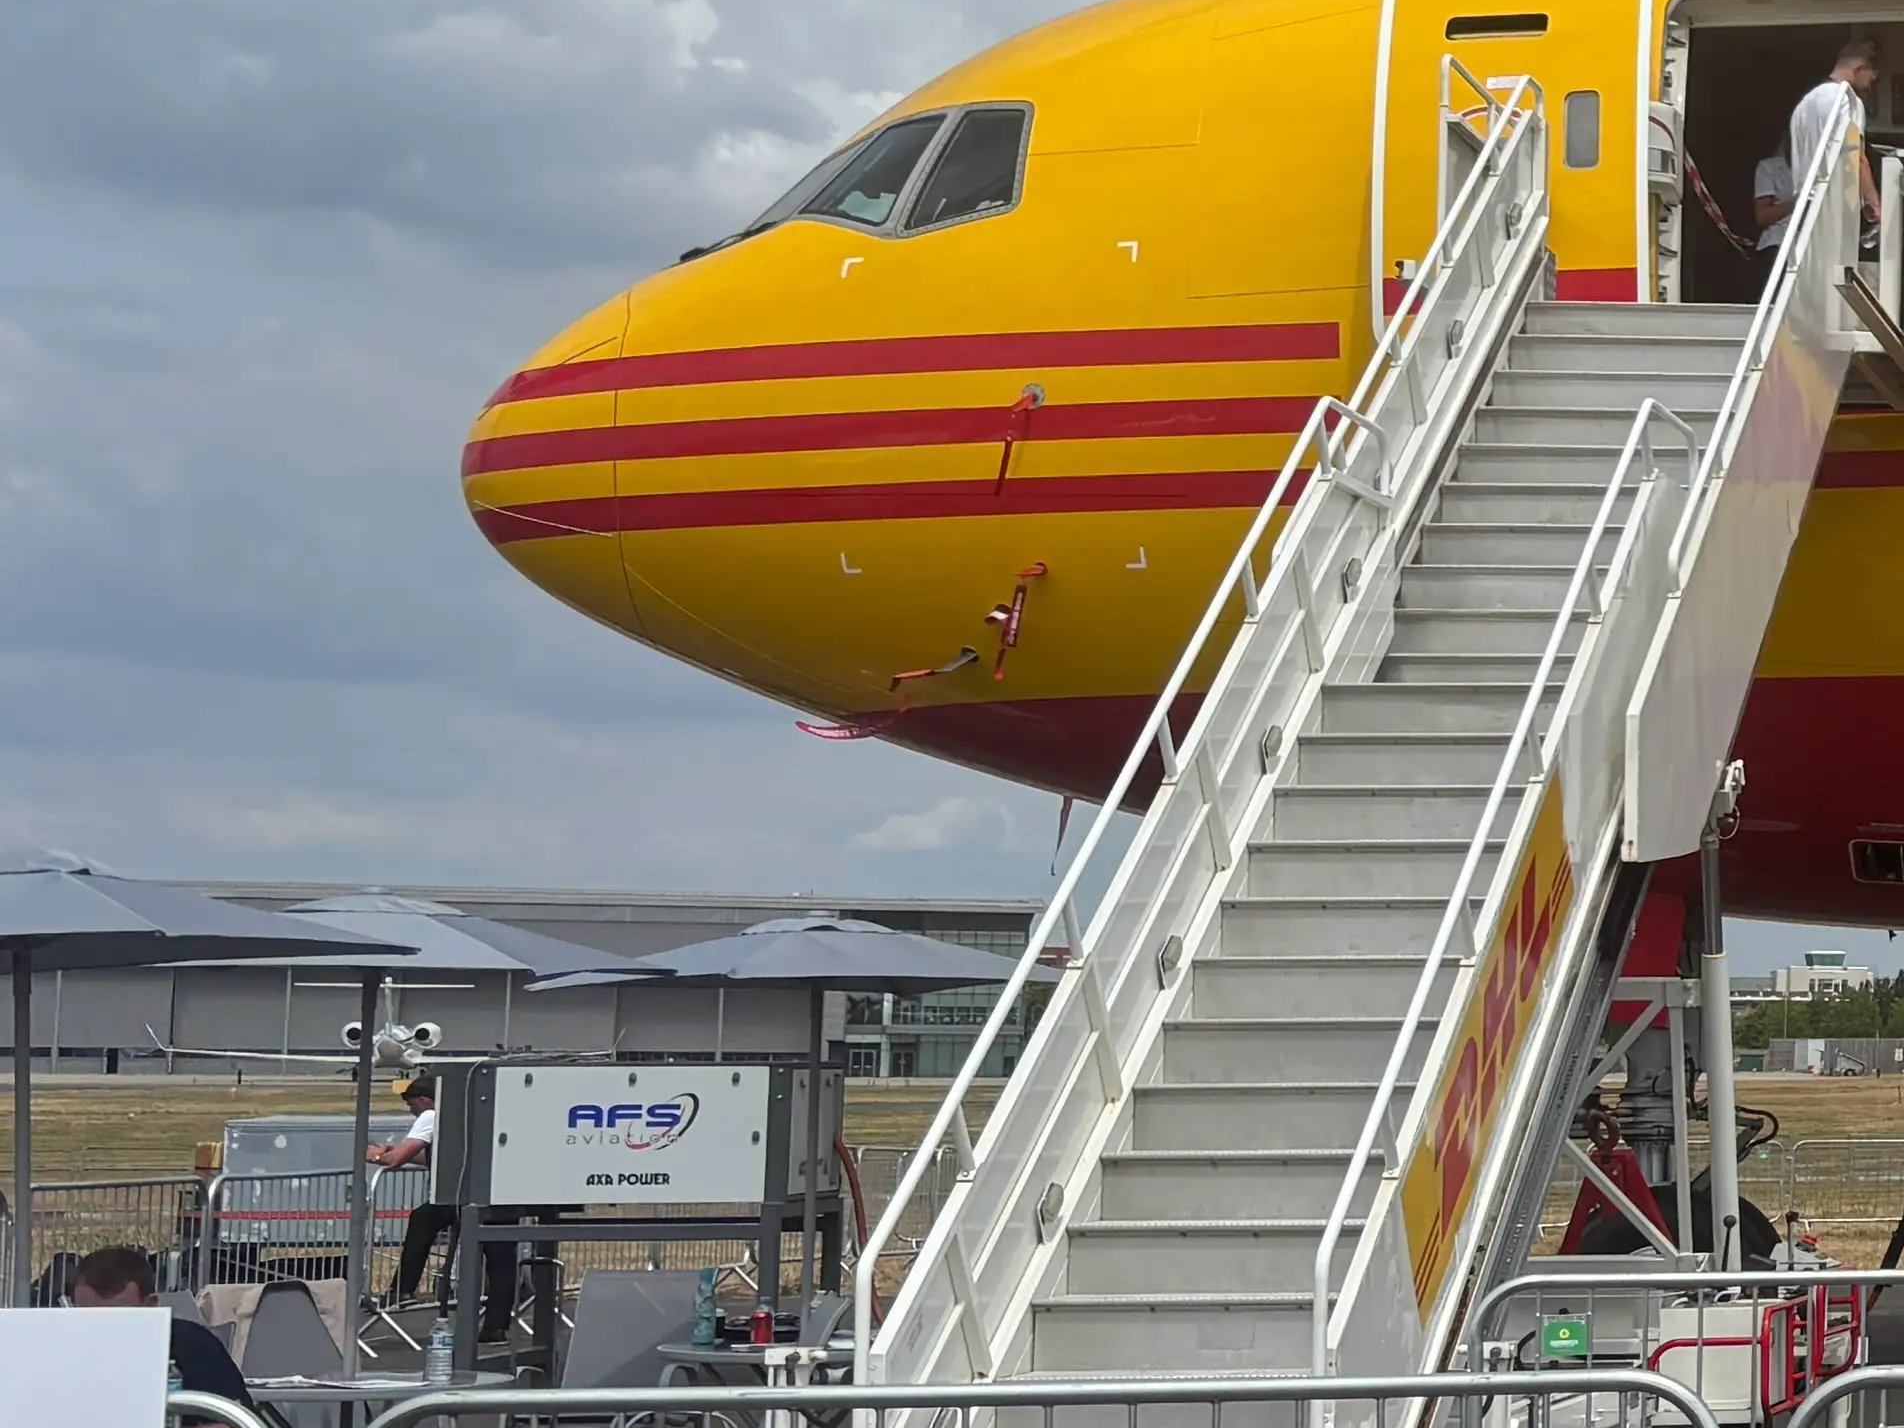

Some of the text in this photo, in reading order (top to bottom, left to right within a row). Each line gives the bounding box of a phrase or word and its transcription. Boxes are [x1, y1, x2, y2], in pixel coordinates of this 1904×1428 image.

[1434, 853, 1552, 1245] DHL
[567, 1103, 683, 1129] AFS
[565, 1129, 680, 1146] aviation
[585, 1172, 671, 1186] AXA POWER
